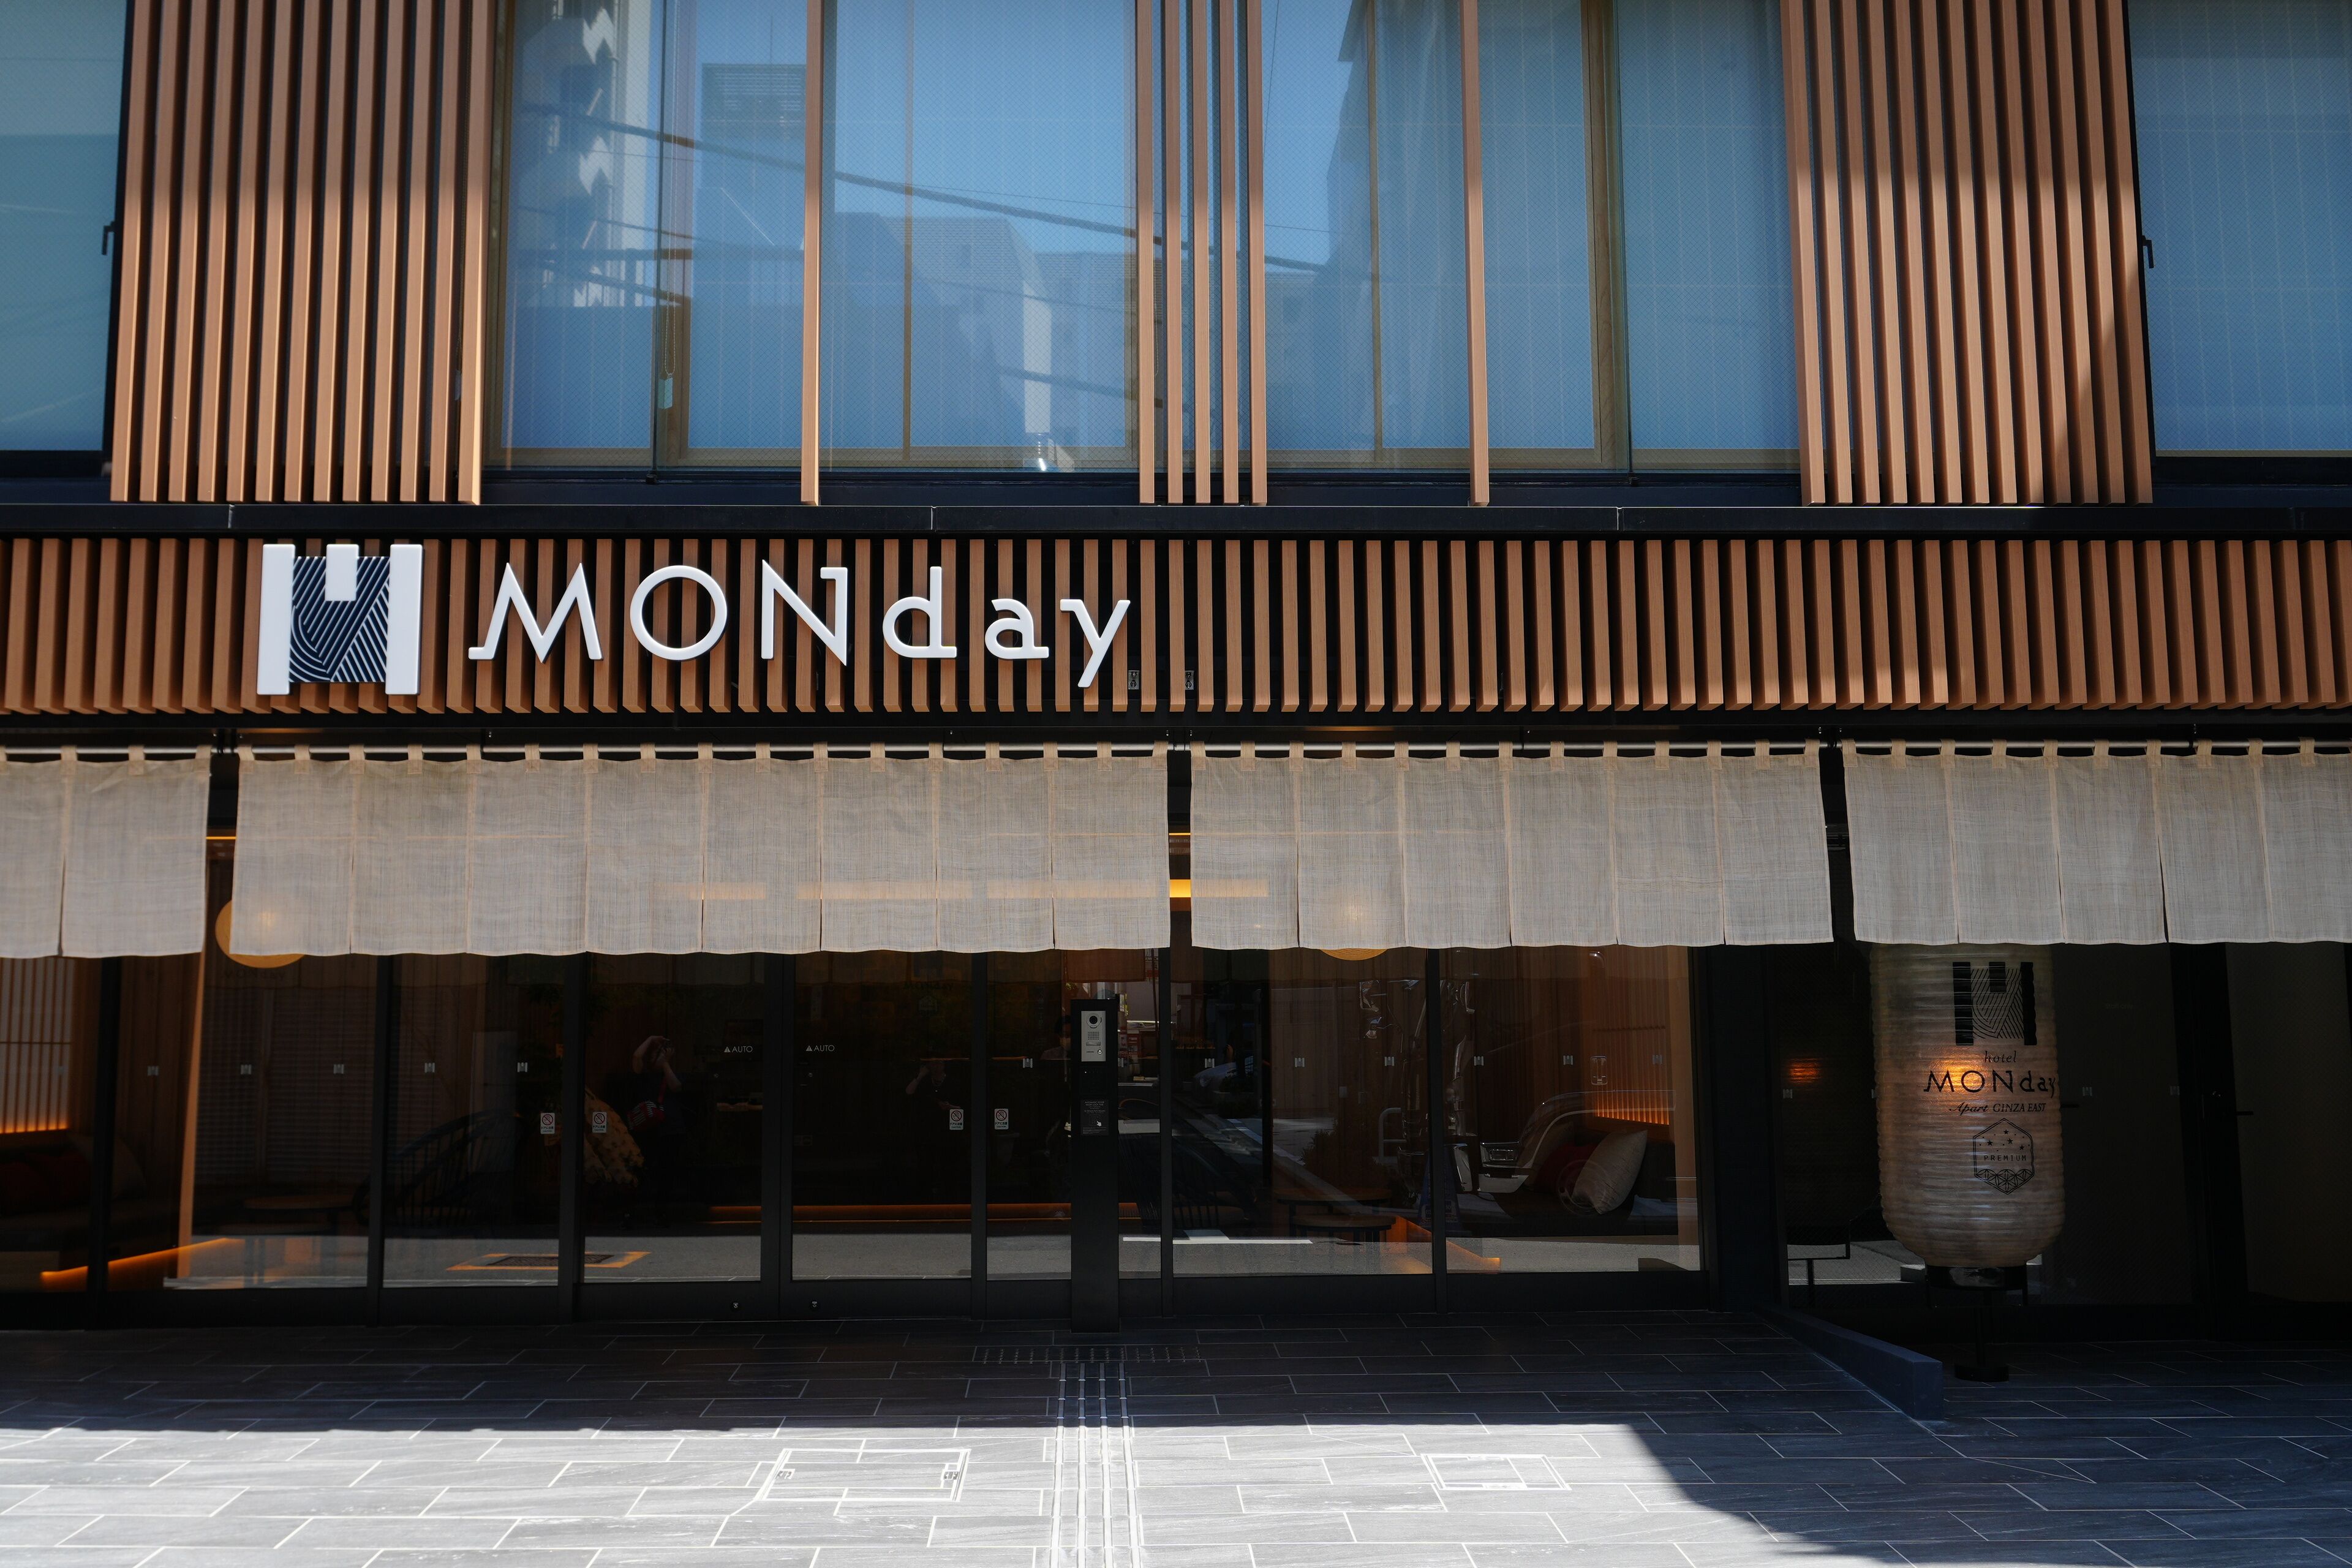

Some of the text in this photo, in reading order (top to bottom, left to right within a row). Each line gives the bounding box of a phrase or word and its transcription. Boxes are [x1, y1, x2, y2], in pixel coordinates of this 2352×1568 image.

[468, 559, 1131, 688] MONday
[1984, 1050, 2016, 1063] hotel
[1923, 1069, 2056, 1098] MONday
[1949, 1102, 2046, 1116] Apart GINZA EAST
